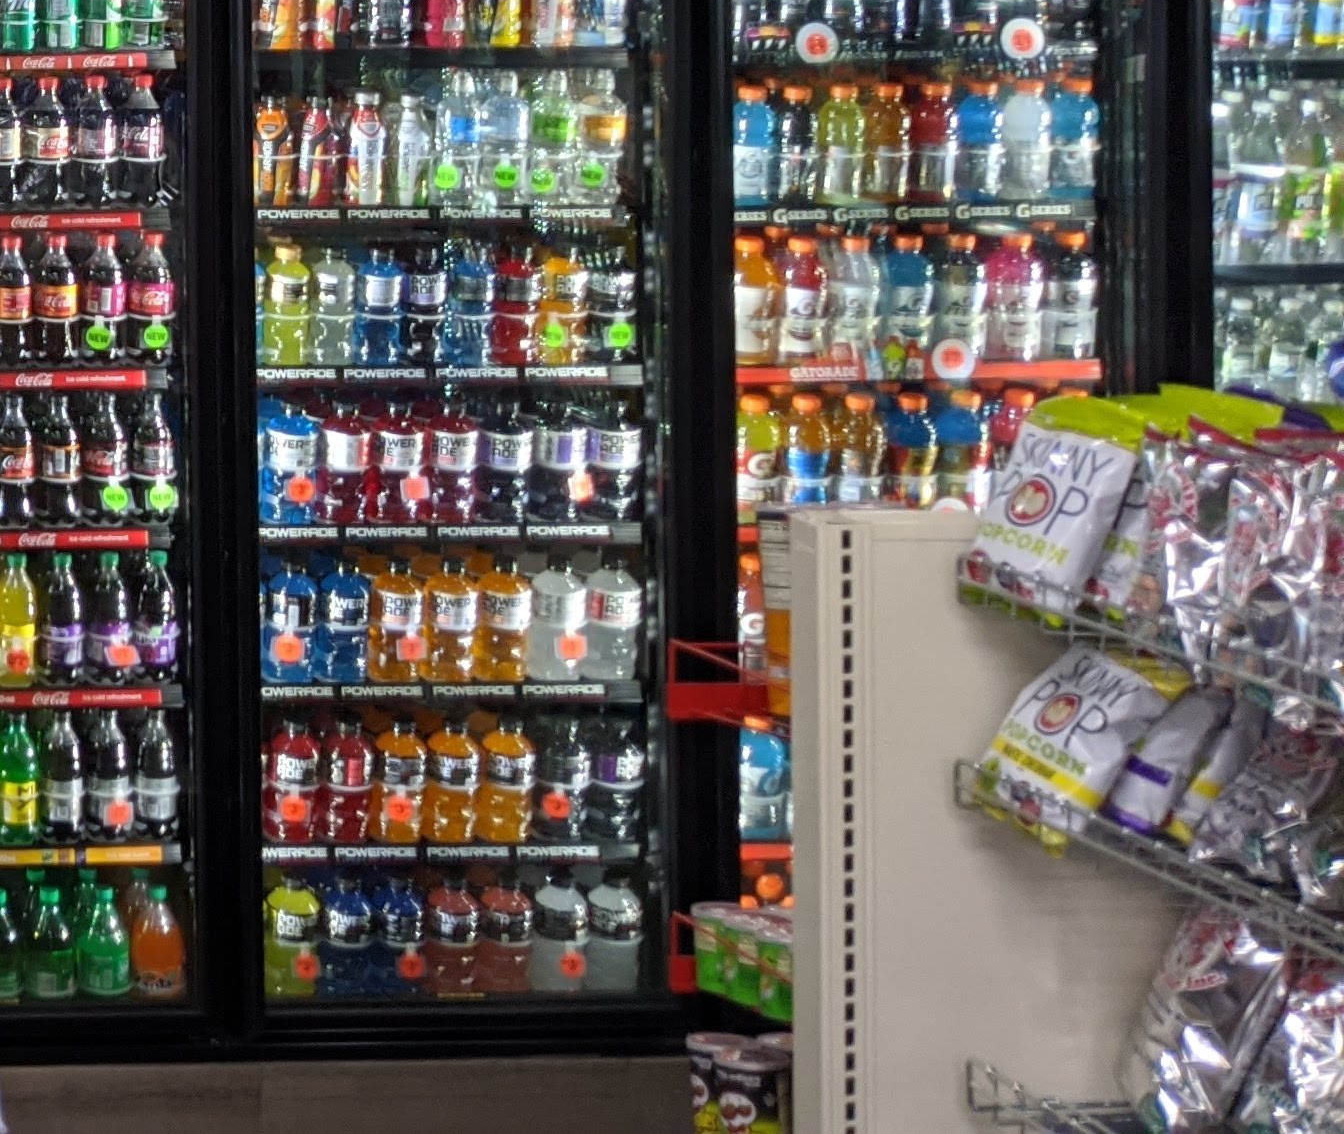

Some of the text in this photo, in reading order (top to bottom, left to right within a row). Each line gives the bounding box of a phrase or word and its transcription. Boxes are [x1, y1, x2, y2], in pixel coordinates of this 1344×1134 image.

[258, 210, 340, 219] POWERADE
[348, 209, 430, 219] POWERADE
[440, 209, 522, 219] POWERADE
[530, 209, 612, 219] POWERADE
[88, 333, 109, 343] NEW
[146, 330, 167, 340] NEW
[344, 369, 426, 379] POWERADE
[436, 368, 518, 378] POWERADE
[525, 367, 608, 377] POWERADE
[346, 527, 428, 537] POWERADE
[438, 527, 520, 536] POWERADE
[526, 526, 609, 536] POWERADE
[1016, 679, 1108, 748] POP
